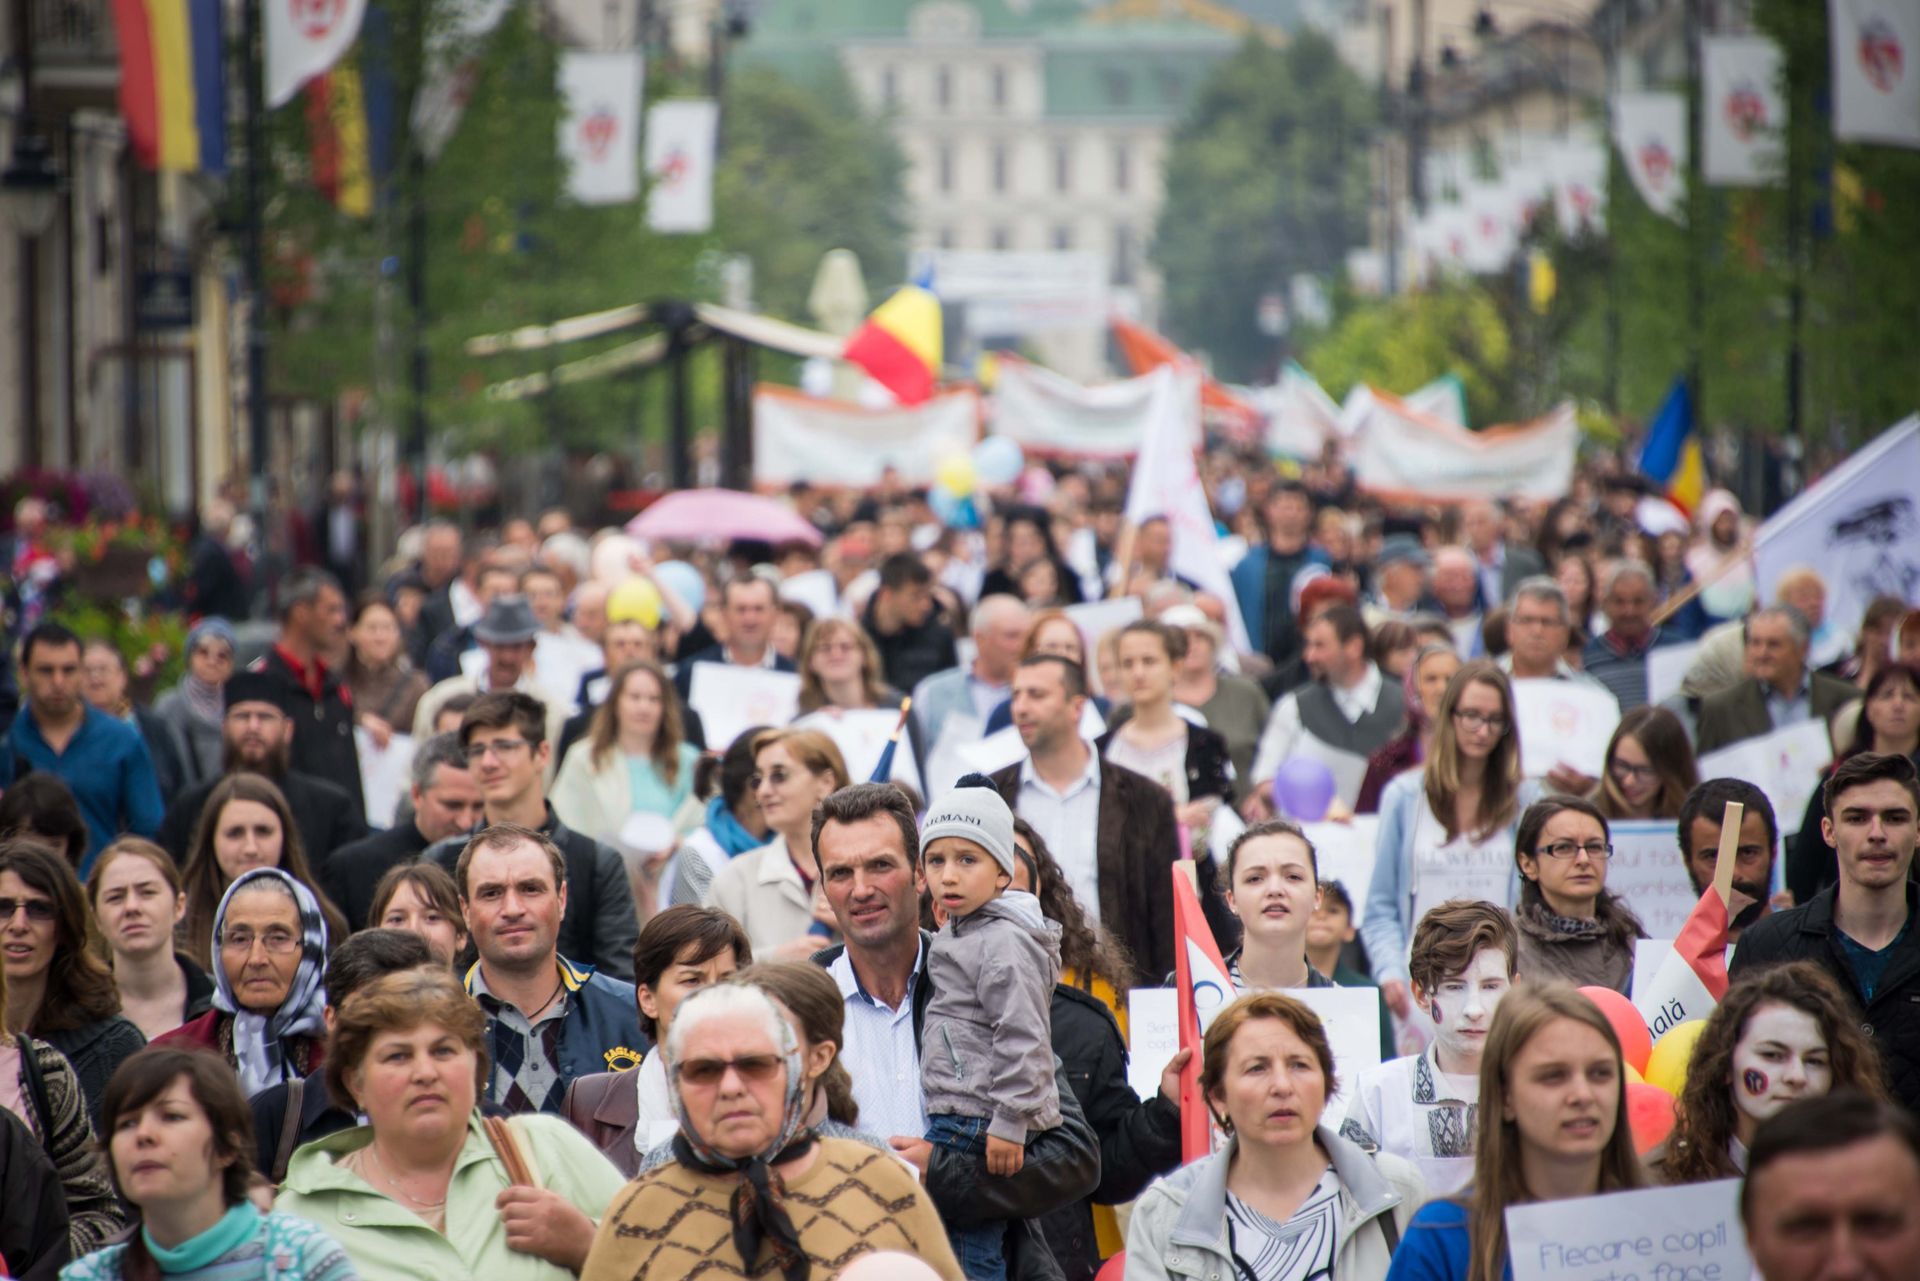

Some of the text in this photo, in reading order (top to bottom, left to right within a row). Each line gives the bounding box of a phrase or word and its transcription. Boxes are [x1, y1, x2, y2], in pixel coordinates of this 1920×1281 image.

[604, 1047, 642, 1062] EAGLES
[1539, 1222, 1727, 1270] Fiecare copil
